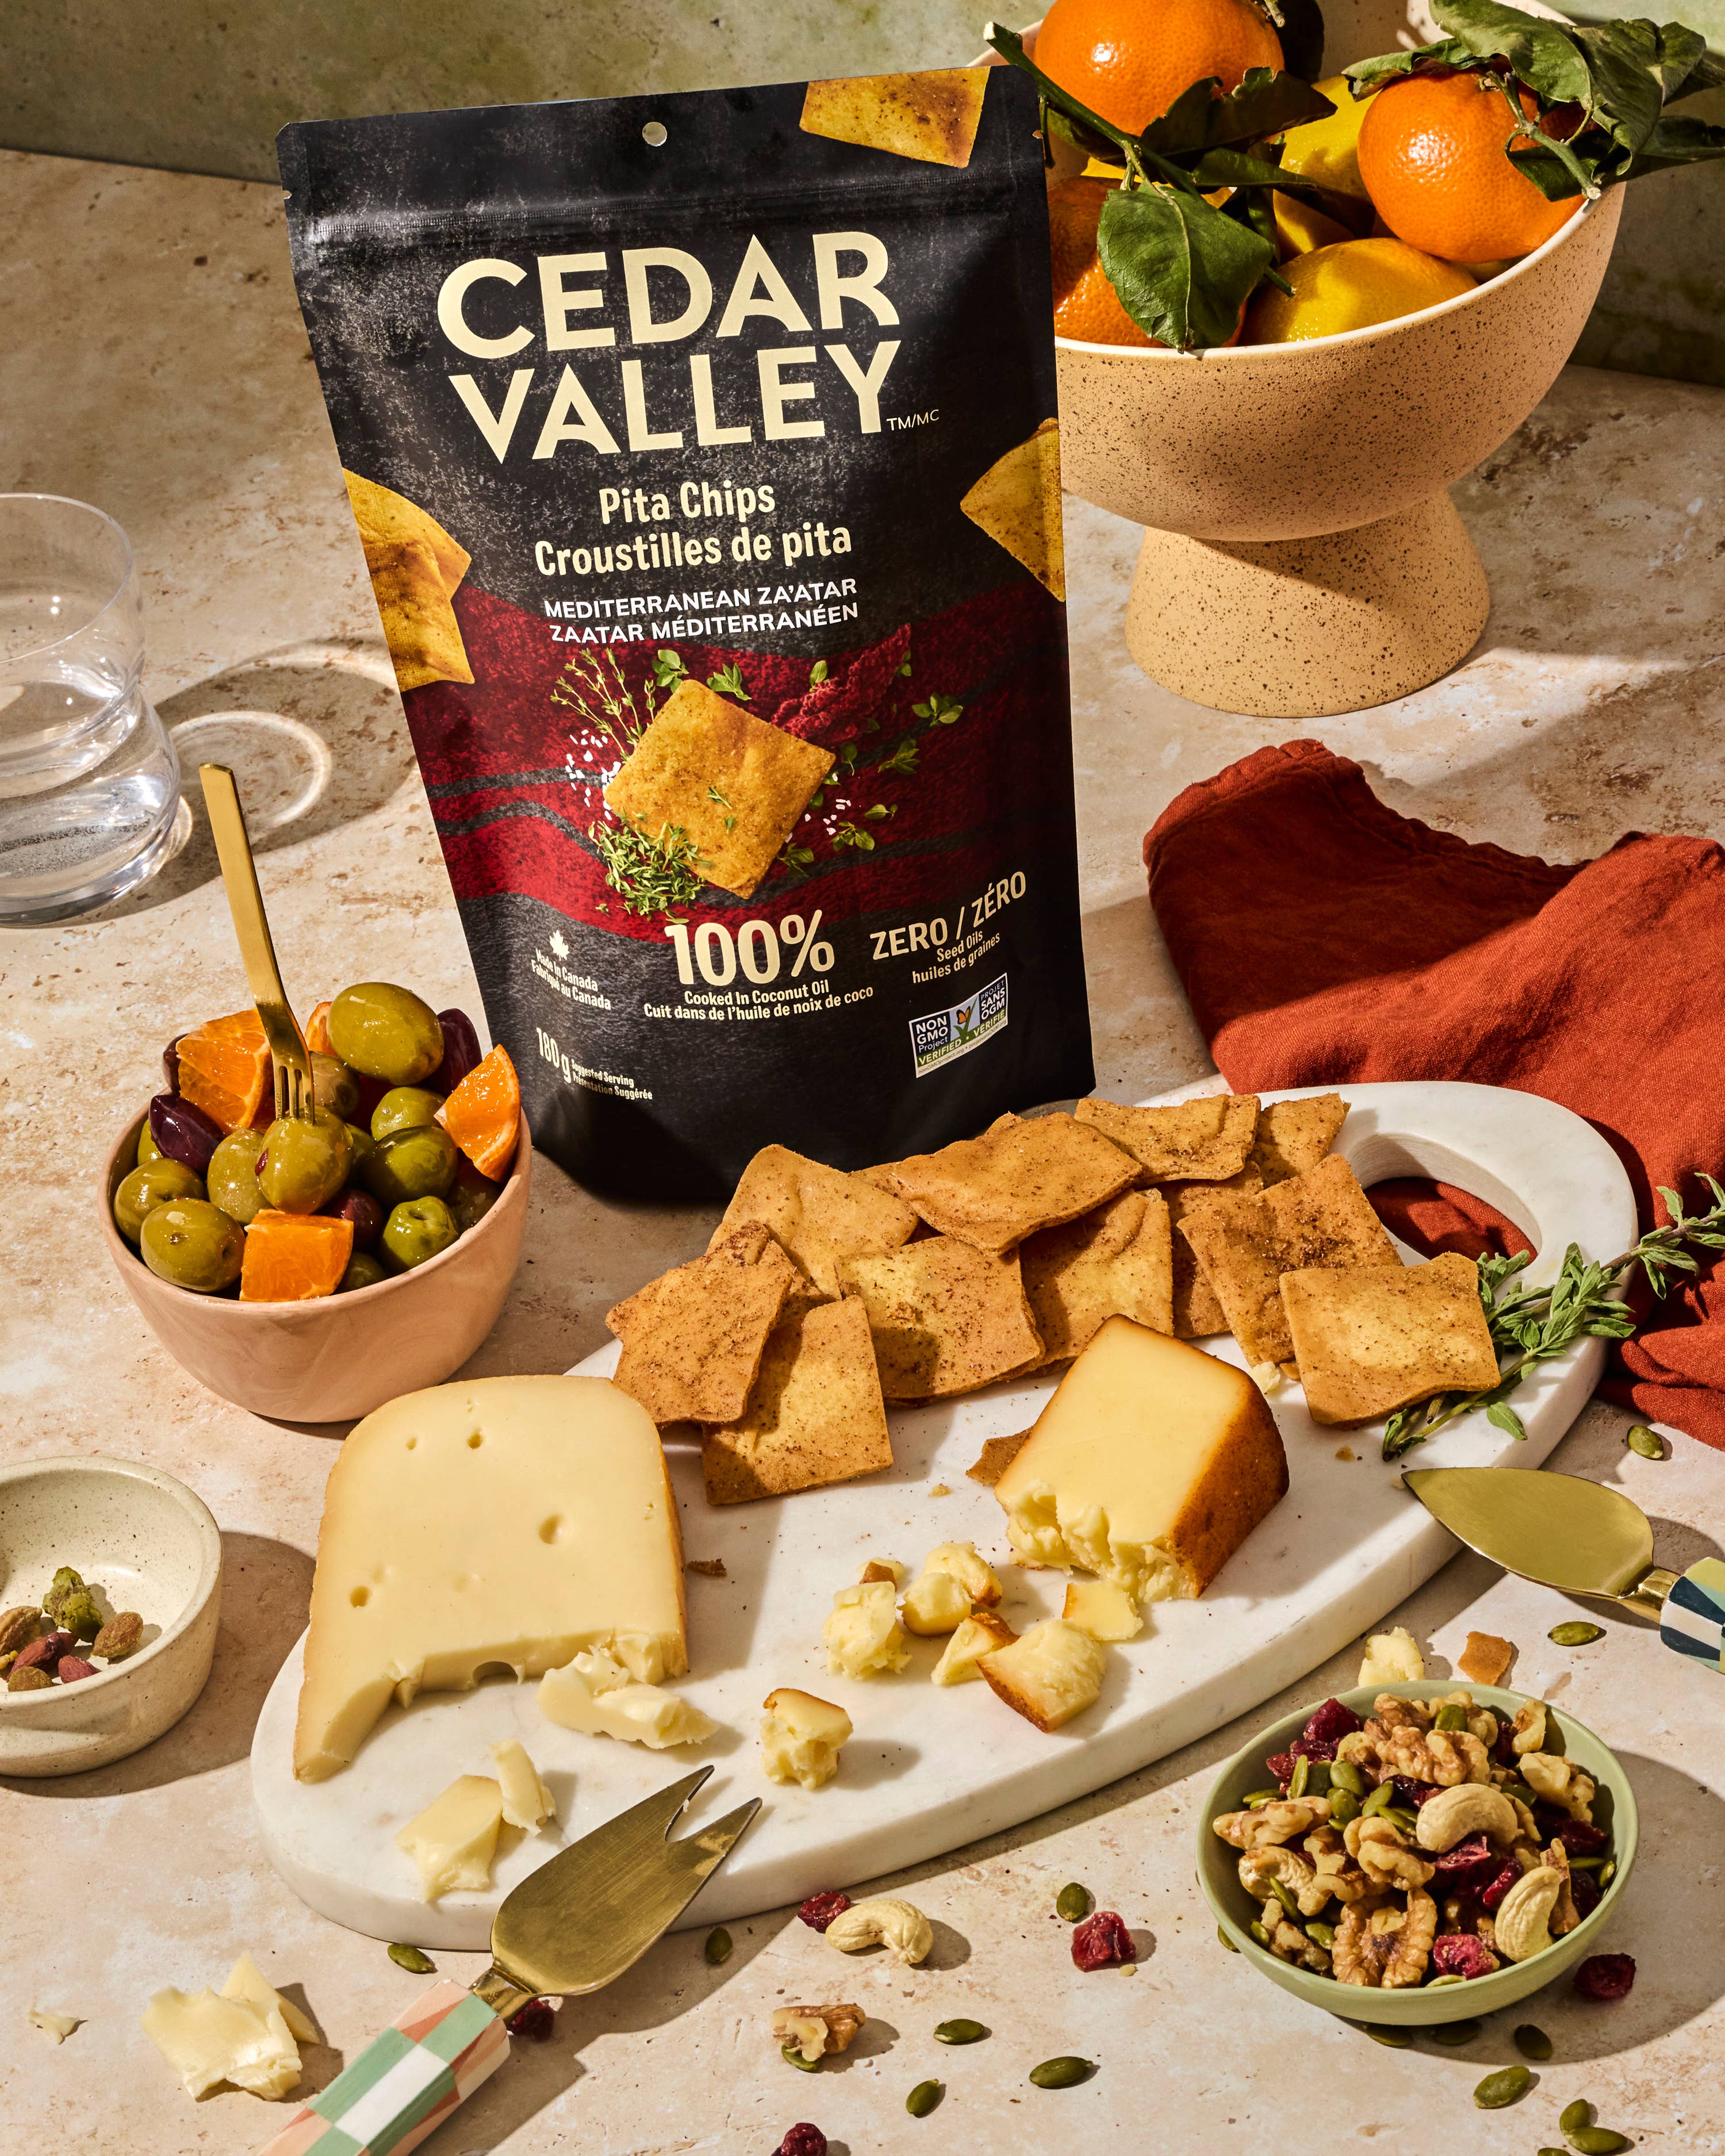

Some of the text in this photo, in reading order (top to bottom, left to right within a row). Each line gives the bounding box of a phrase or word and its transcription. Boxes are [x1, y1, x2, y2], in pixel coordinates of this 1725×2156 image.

[438, 231, 900, 359] CEDAR
[448, 340, 940, 464] VALLEY TM/MC
[599, 479, 775, 524] Pita Chips
[535, 521, 852, 576] Croustilles de pita
[544, 588, 750, 618] MEDITERRANEAN
[549, 602, 858, 644] ZAATAR MÉDITERRANÉEN
[870, 918, 948, 960] ZERO
[971, 871, 1026, 928] ZÉRO
[665, 910, 835, 986] 100%
[913, 931, 1000, 984] huiles de graines
[937, 929, 983, 962] Seed Oils
[531, 959, 611, 1010] Fabriqué au Canada
[535, 948, 598, 992] Made In Canada
[644, 1003, 672, 1019] Cuit
[674, 1004, 706, 1020] dans
[708, 1006, 725, 1021] de
[773, 1002, 791, 1017] de
[793, 998, 822, 1015] noix
[825, 994, 841, 1008] de
[844, 987, 874, 1004] coco
[684, 979, 829, 1006] Cooked In Coconut Oil
[980, 980, 1005, 1001] PROJET
[981, 987, 1005, 1011] SANS
[916, 1015, 947, 1034] NON
[981, 998, 1005, 1020] OGM
[917, 1026, 948, 1045] GMO
[918, 1038, 961, 1065] VERIFIED
[919, 1036, 948, 1053] Project
[536, 1027, 572, 1084] 180 g
[571, 1058, 635, 1088] Suggested Serving
[614, 1085, 653, 1100] Suggérée
